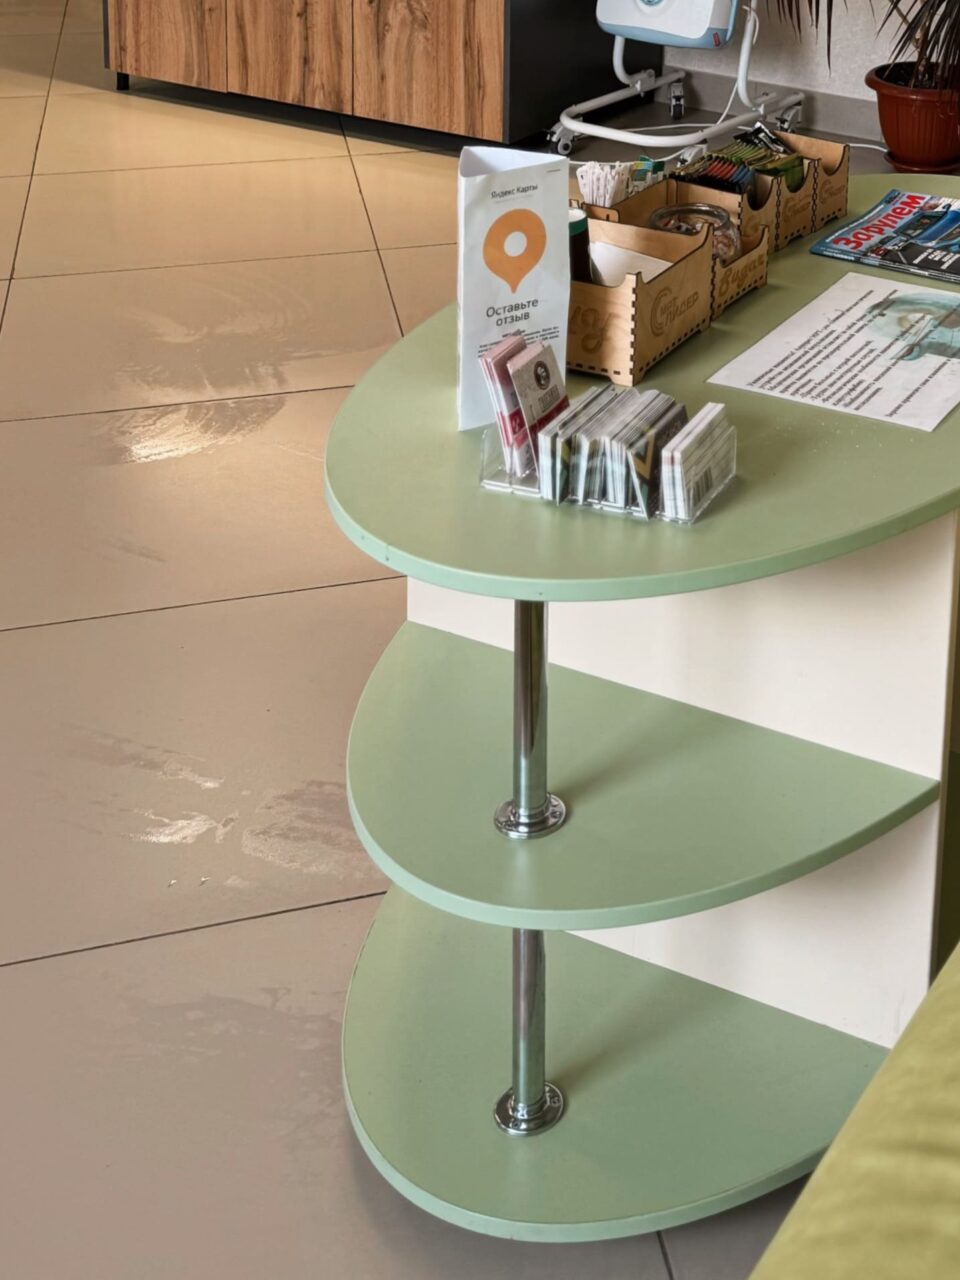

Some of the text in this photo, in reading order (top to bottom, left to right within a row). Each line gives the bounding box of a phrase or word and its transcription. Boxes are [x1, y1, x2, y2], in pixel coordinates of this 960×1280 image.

[490, 184, 538, 199] Яндекс Карты
[486, 298, 539, 318] Оставьте
[495, 312, 531, 327] отзыв
